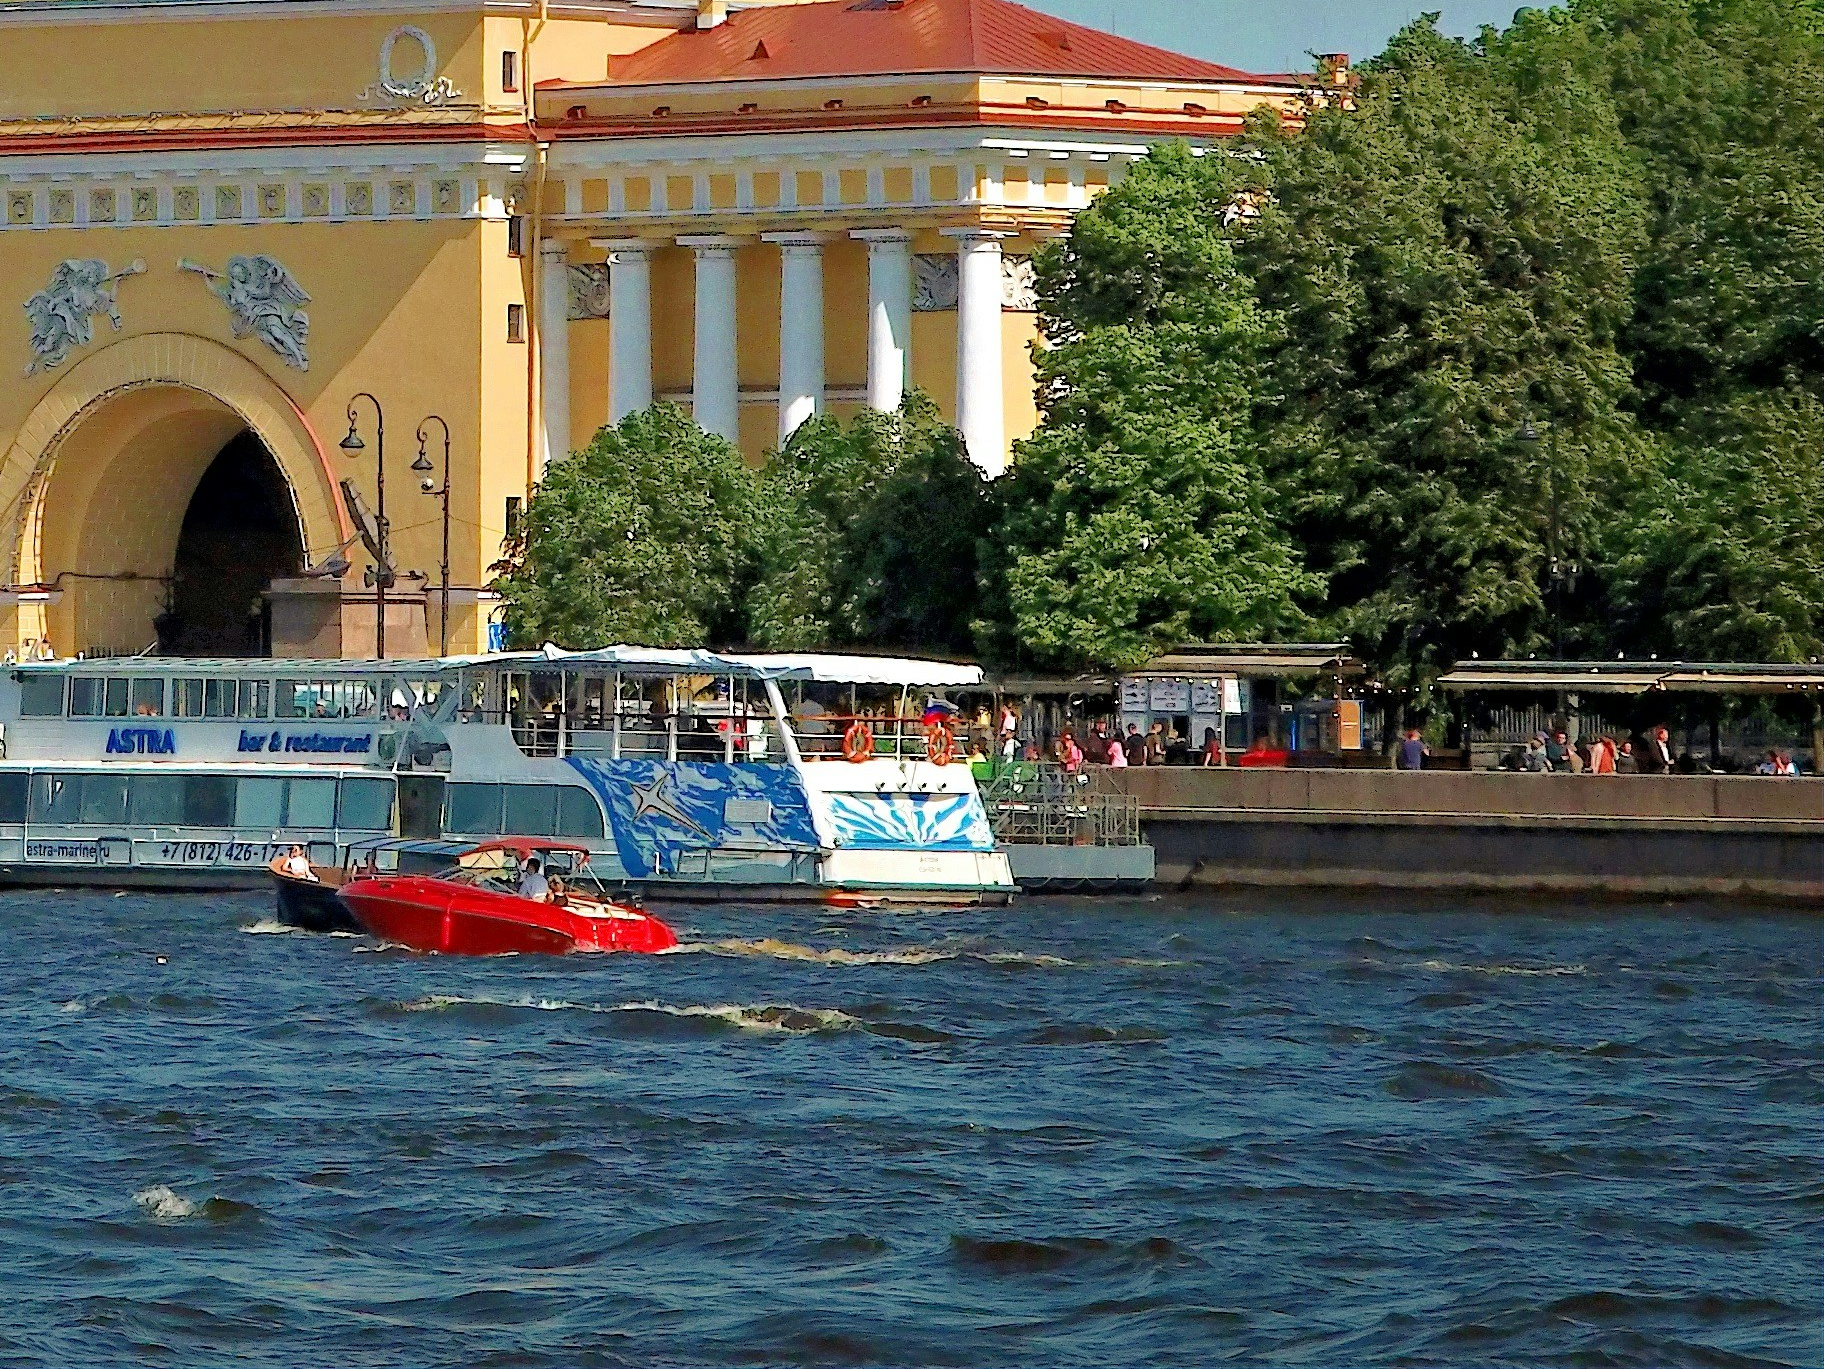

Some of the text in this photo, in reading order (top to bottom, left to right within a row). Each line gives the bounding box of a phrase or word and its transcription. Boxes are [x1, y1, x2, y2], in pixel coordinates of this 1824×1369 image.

[105, 729, 175, 754] ASTRA
[237, 729, 371, 753] bar & restaurant
